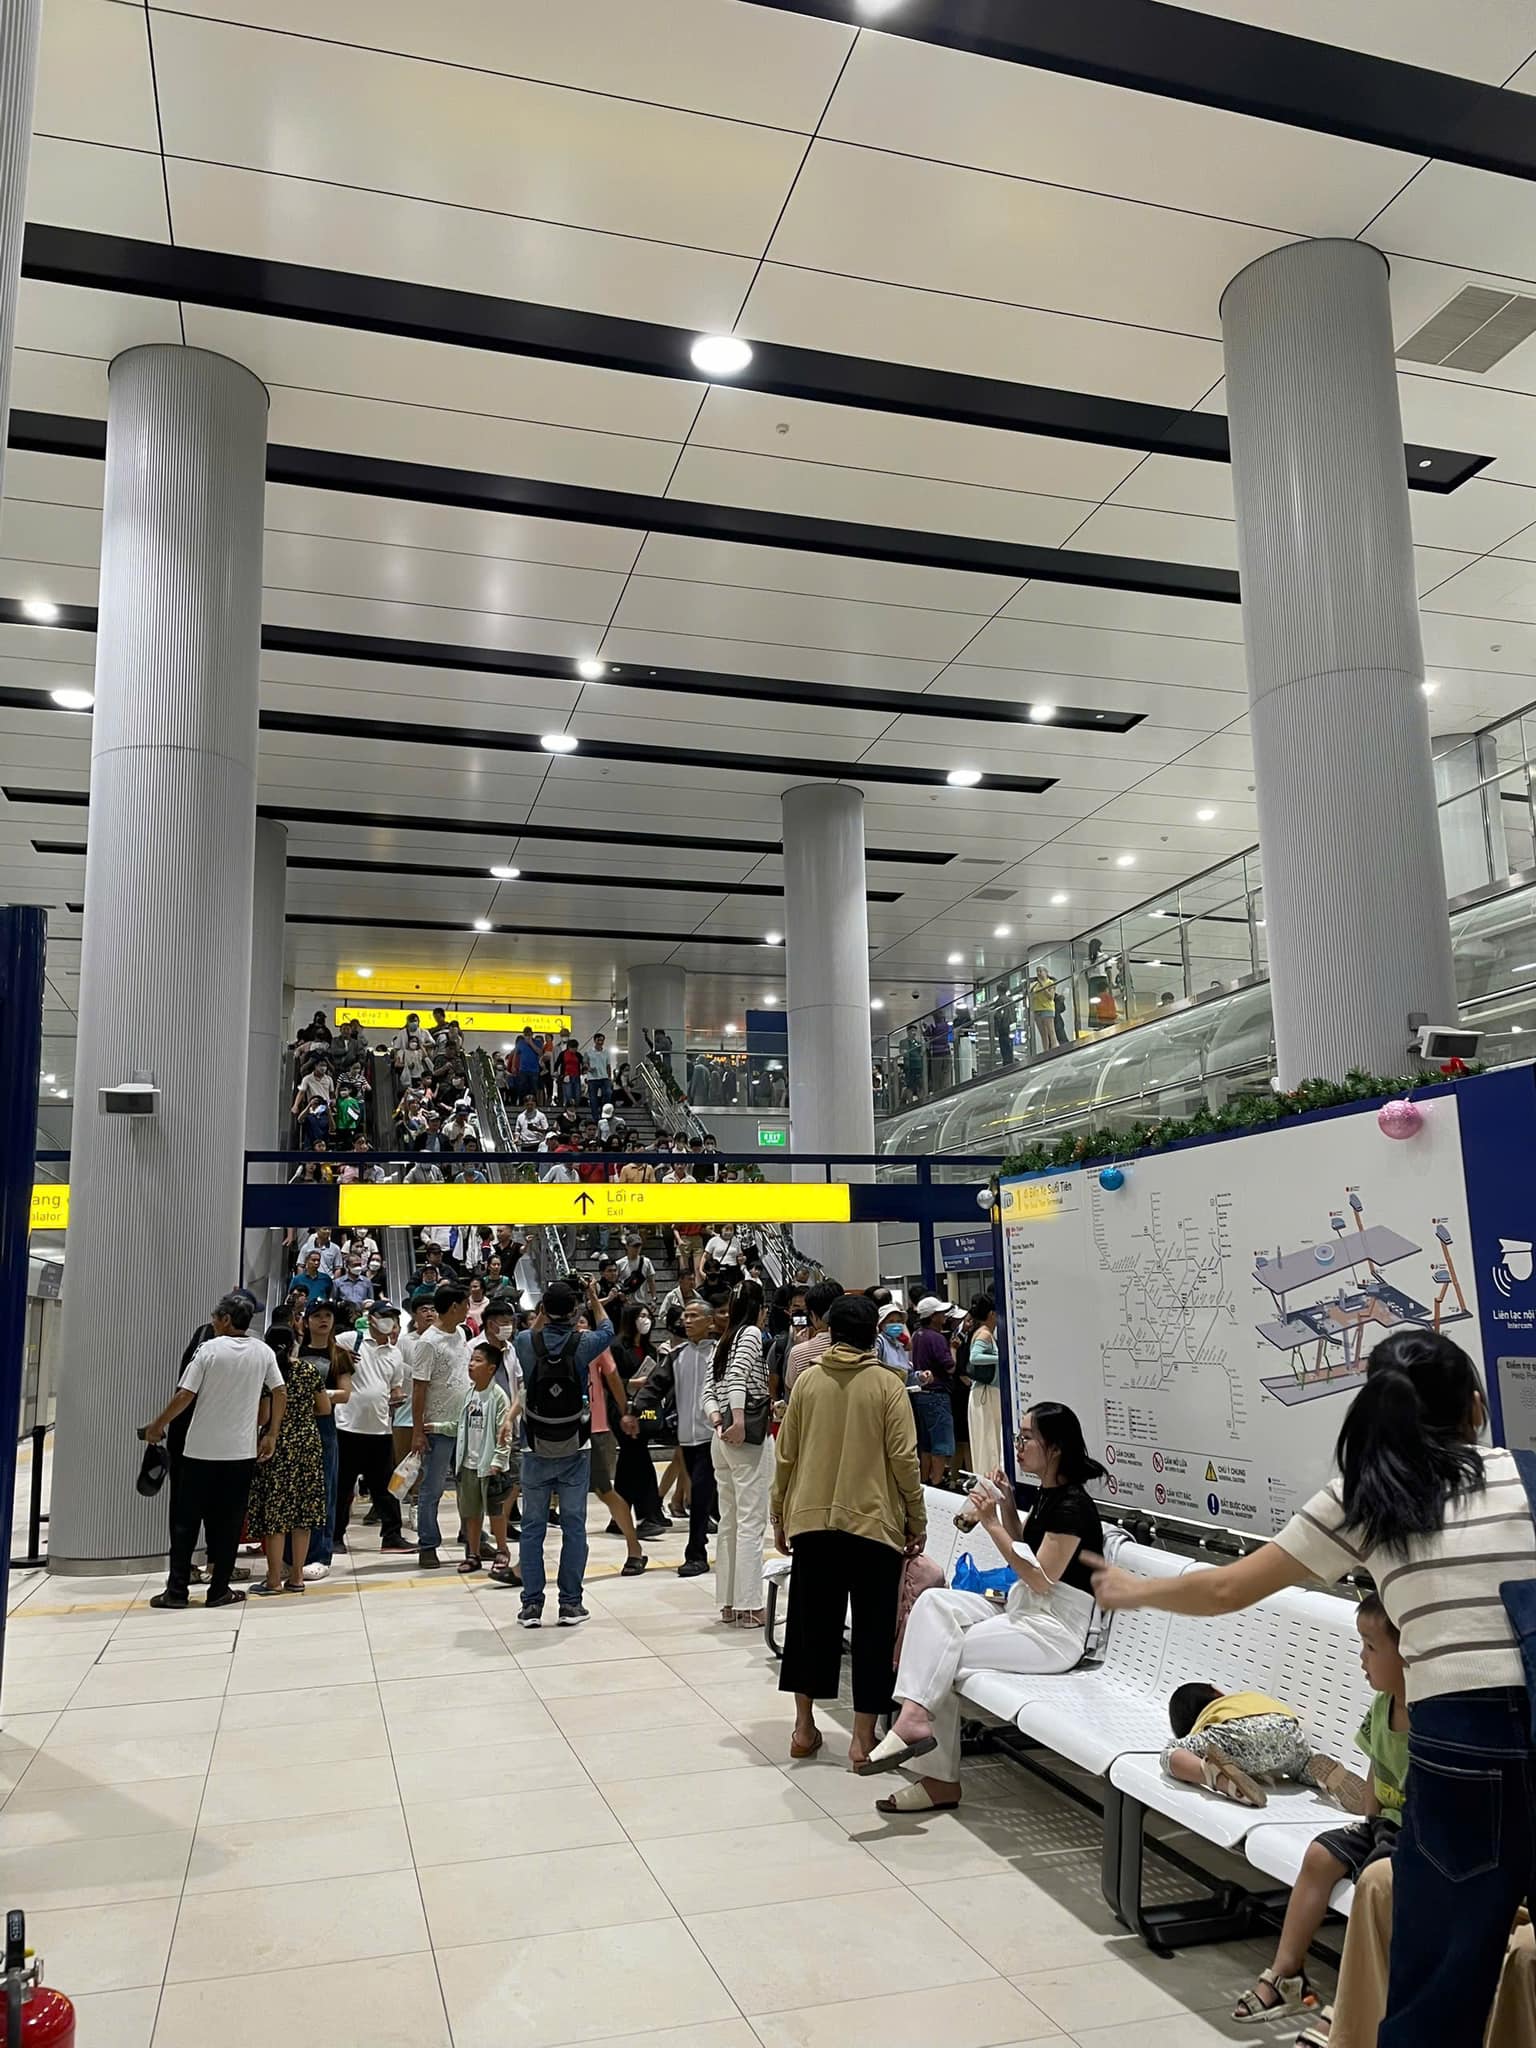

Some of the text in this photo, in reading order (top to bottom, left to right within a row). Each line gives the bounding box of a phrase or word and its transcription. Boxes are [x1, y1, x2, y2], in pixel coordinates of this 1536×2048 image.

[32, 1195, 61, 1209] ang
[607, 1189, 645, 1203] Lối ra
[607, 1207, 624, 1216] Exit
[1492, 1309, 1510, 1321] Liên
[1510, 1310, 1522, 1322] lạc
